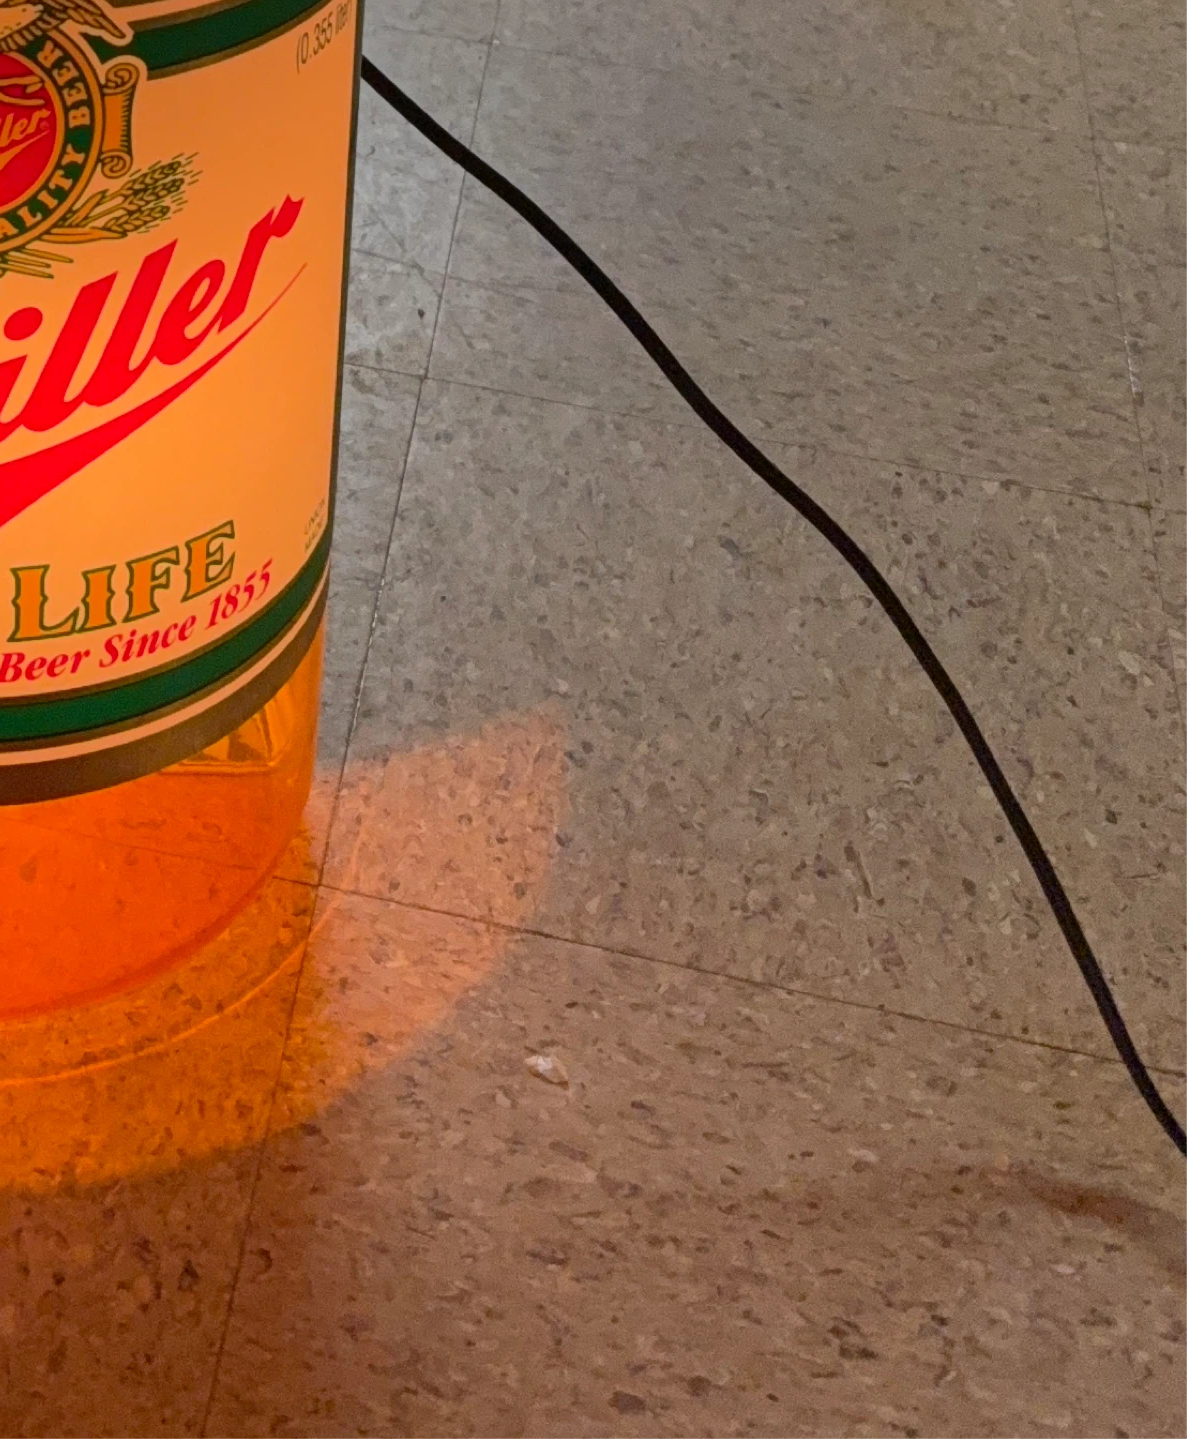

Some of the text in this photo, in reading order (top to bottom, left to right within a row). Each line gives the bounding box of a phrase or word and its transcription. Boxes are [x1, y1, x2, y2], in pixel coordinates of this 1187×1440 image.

[37, 39, 91, 129] BEER
[7, 520, 237, 643] LIFE
[98, 615, 198, 669] Since
[204, 557, 274, 630] 1855
